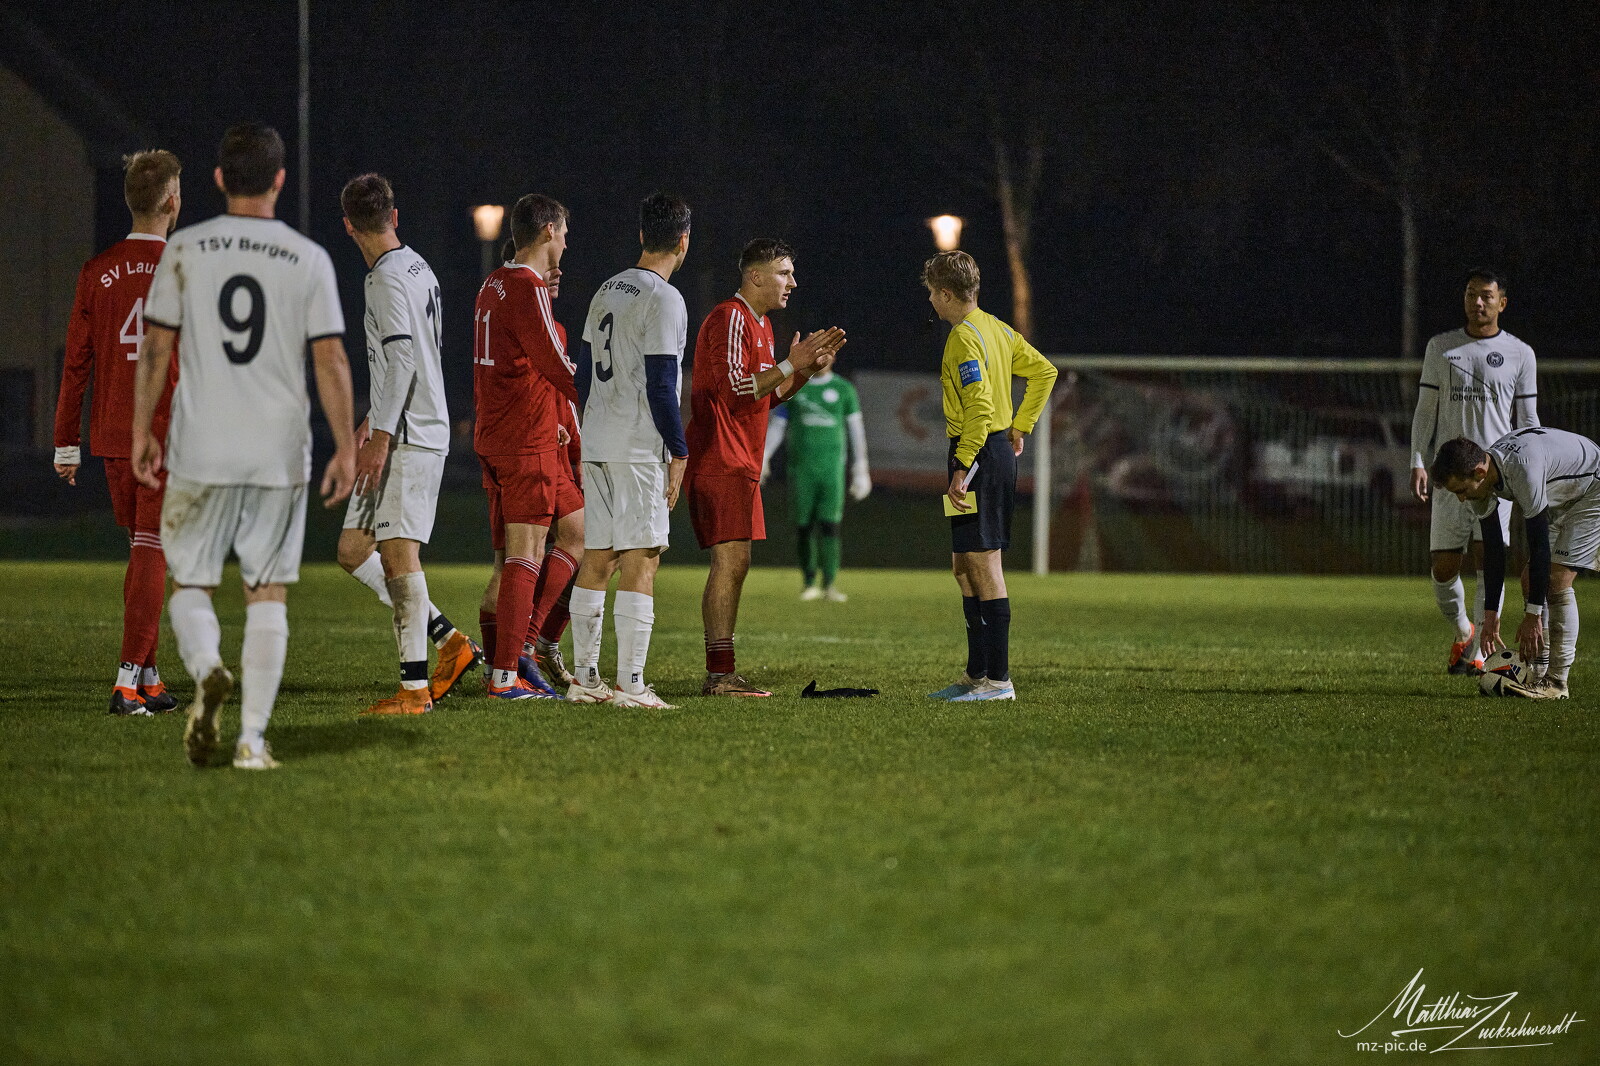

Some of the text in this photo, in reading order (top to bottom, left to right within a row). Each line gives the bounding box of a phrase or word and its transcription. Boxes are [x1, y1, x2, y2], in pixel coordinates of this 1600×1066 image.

[100, 261, 159, 288] SV Lau
[198, 236, 299, 266] TSV Bergen
[615, 280, 641, 297] Bergen
[119, 297, 147, 361] 4
[218, 273, 267, 365] 9
[473, 308, 495, 366] 11
[595, 312, 614, 383] 3
